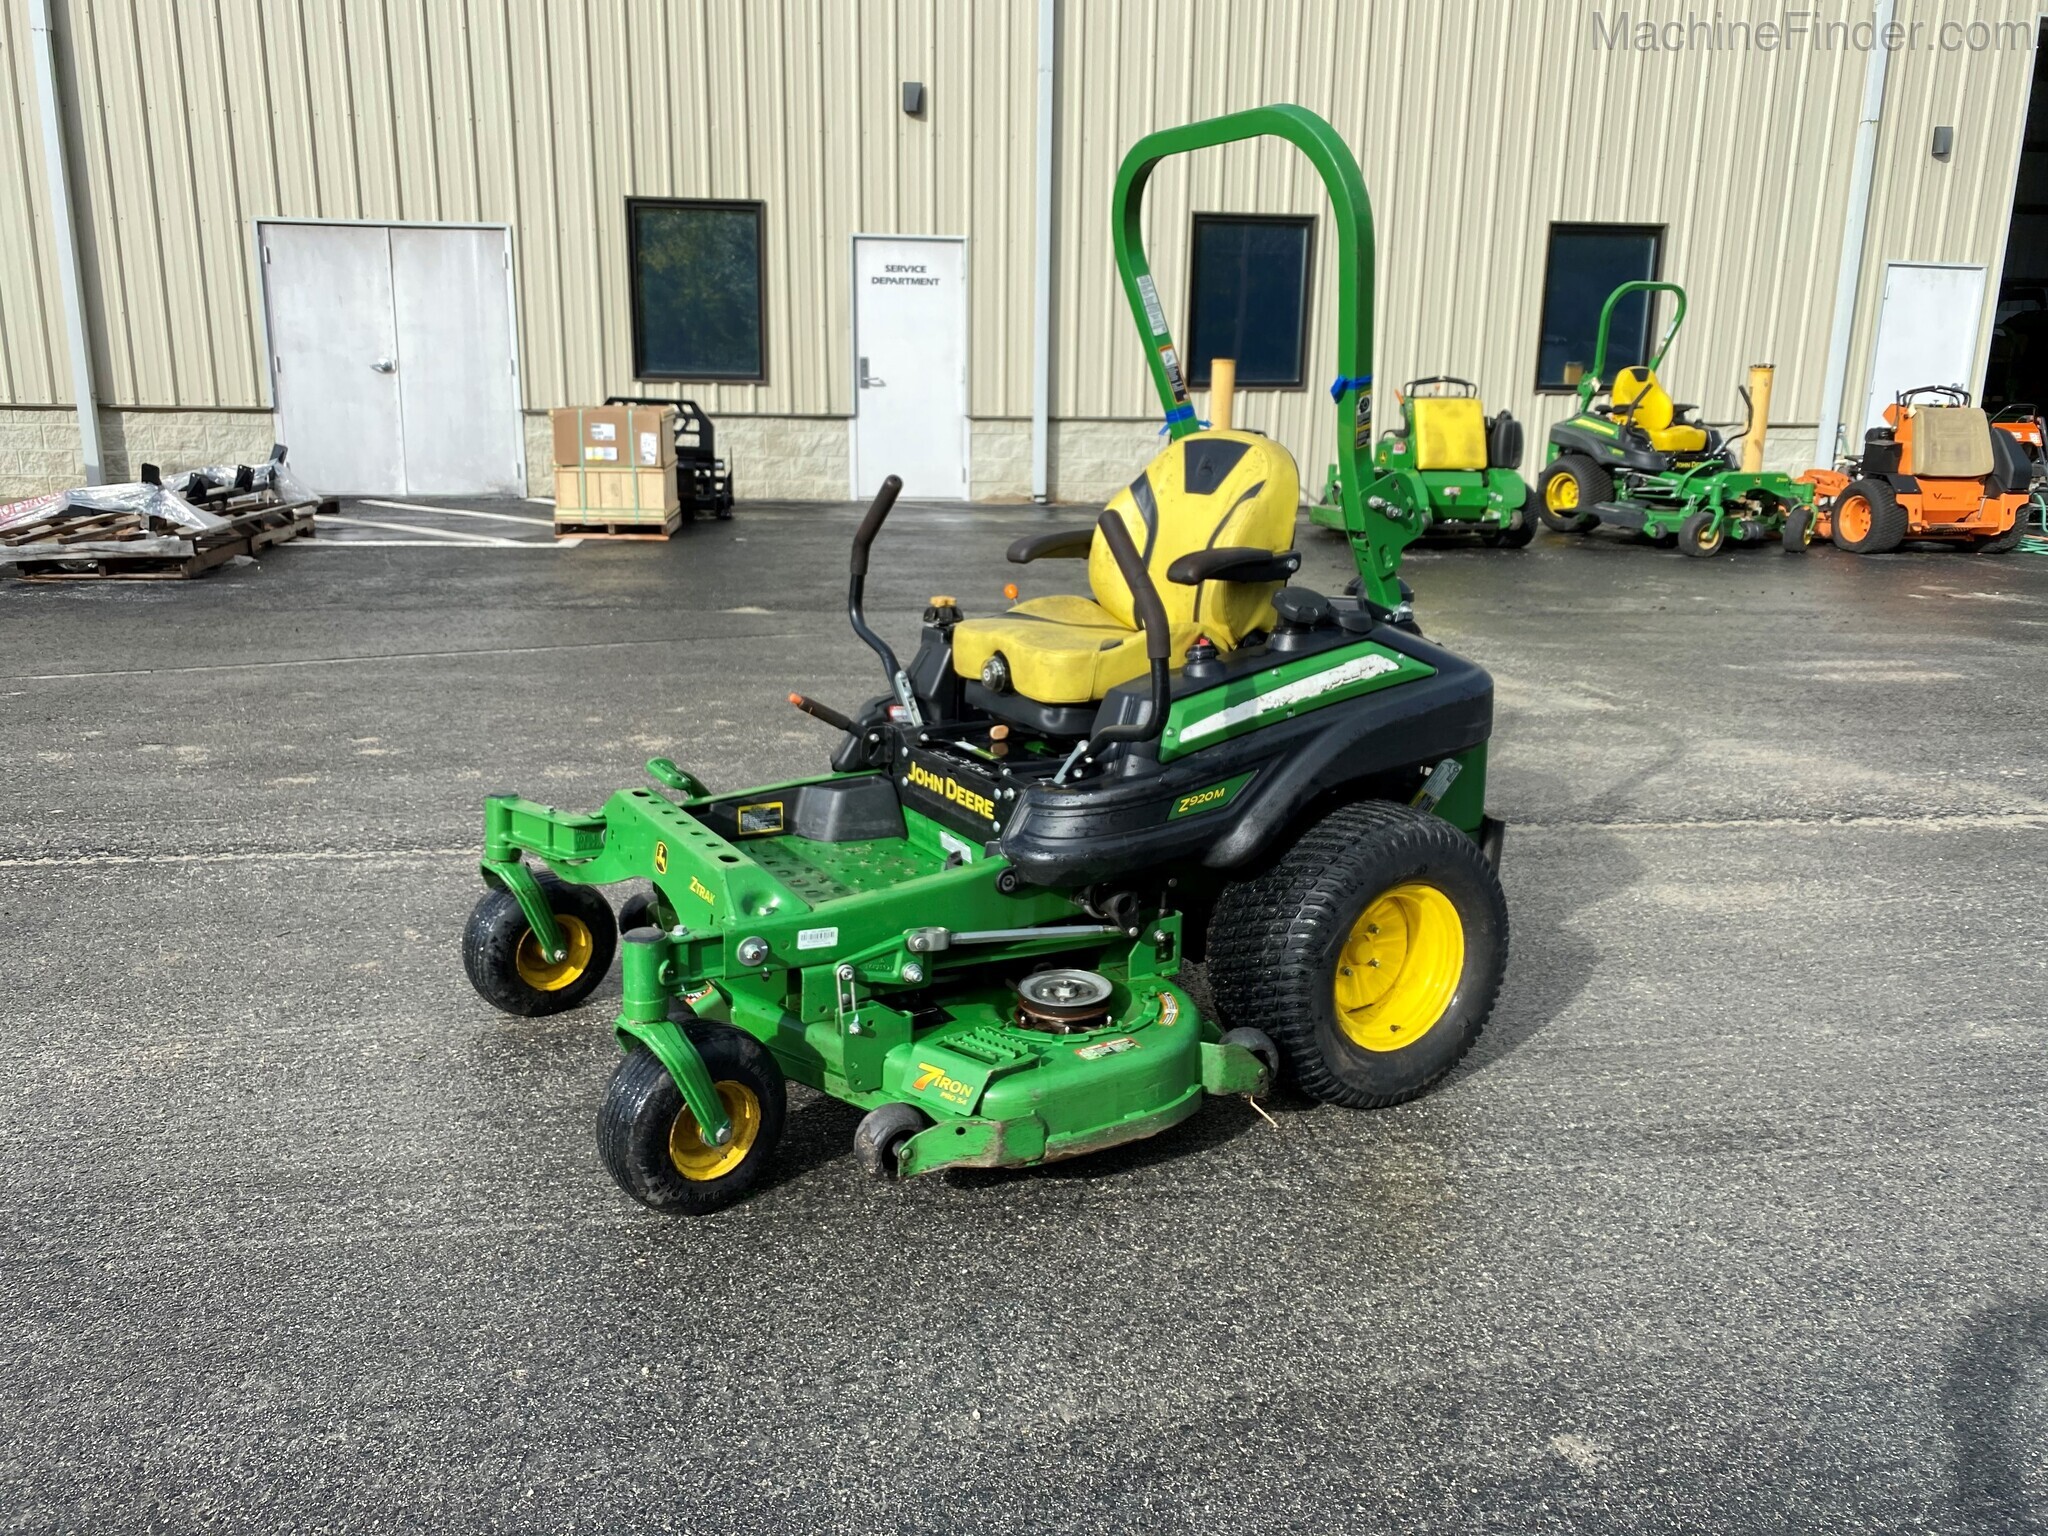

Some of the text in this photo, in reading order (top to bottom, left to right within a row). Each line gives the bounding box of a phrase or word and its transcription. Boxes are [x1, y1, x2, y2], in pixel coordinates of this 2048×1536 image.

[871, 276, 940, 286] DEPARTMENT
[885, 264, 927, 274] SERVICE
[908, 761, 943, 795] JOHN
[945, 777, 995, 820] DEERE
[1178, 787, 1226, 812] Z920M
[689, 875, 716, 906] ZTRAK
